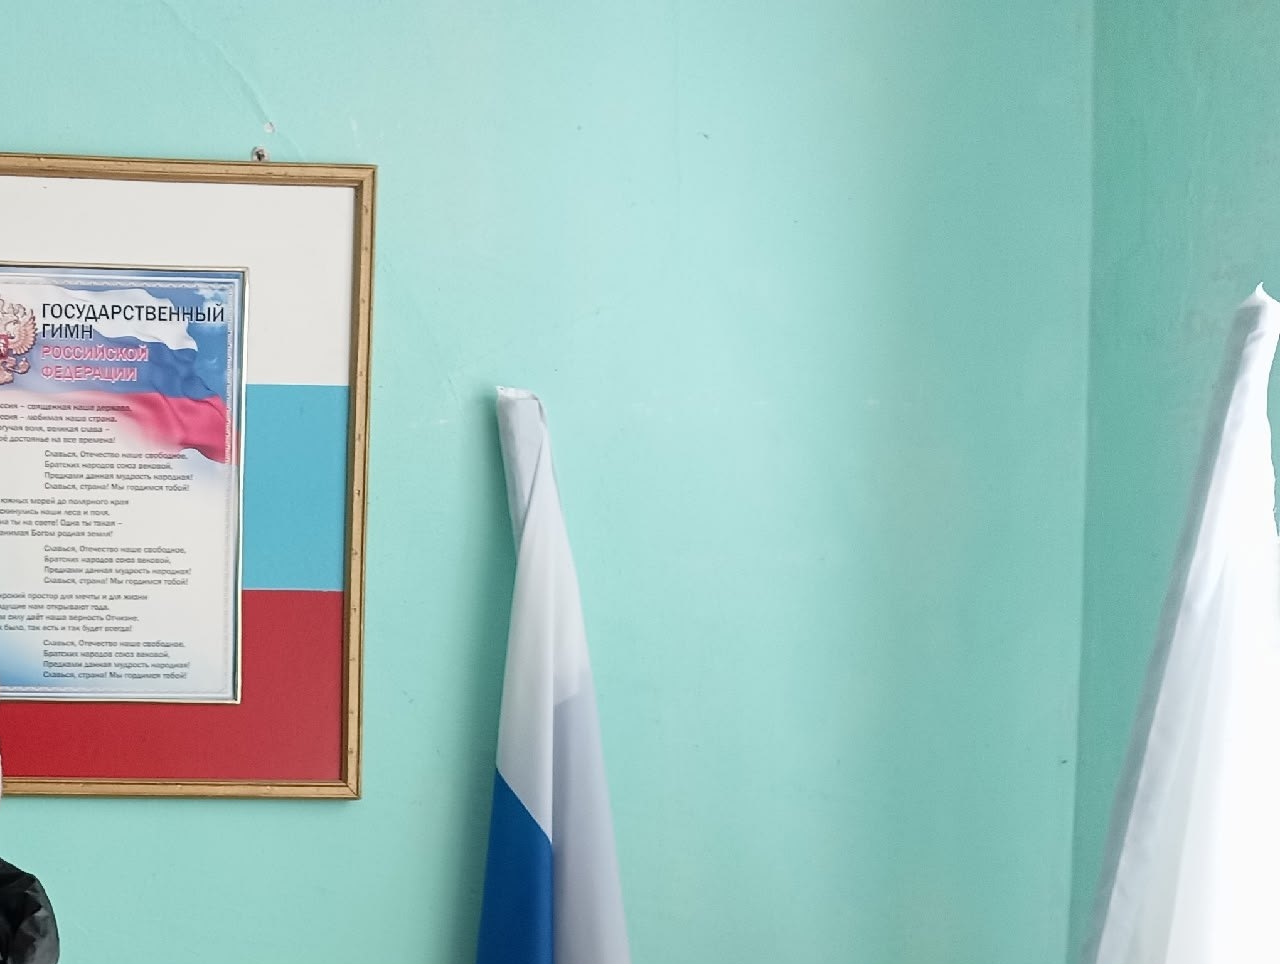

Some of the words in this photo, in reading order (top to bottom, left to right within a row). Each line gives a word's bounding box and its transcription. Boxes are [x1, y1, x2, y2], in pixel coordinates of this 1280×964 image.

[42, 303, 225, 323] ГОСУДАРСТВЕННЫЙ
[42, 323, 94, 340] ГИМН
[41, 344, 149, 362] РОССИЙСКОЙ
[41, 366, 138, 383] ФЕДЕРАЦИИ
